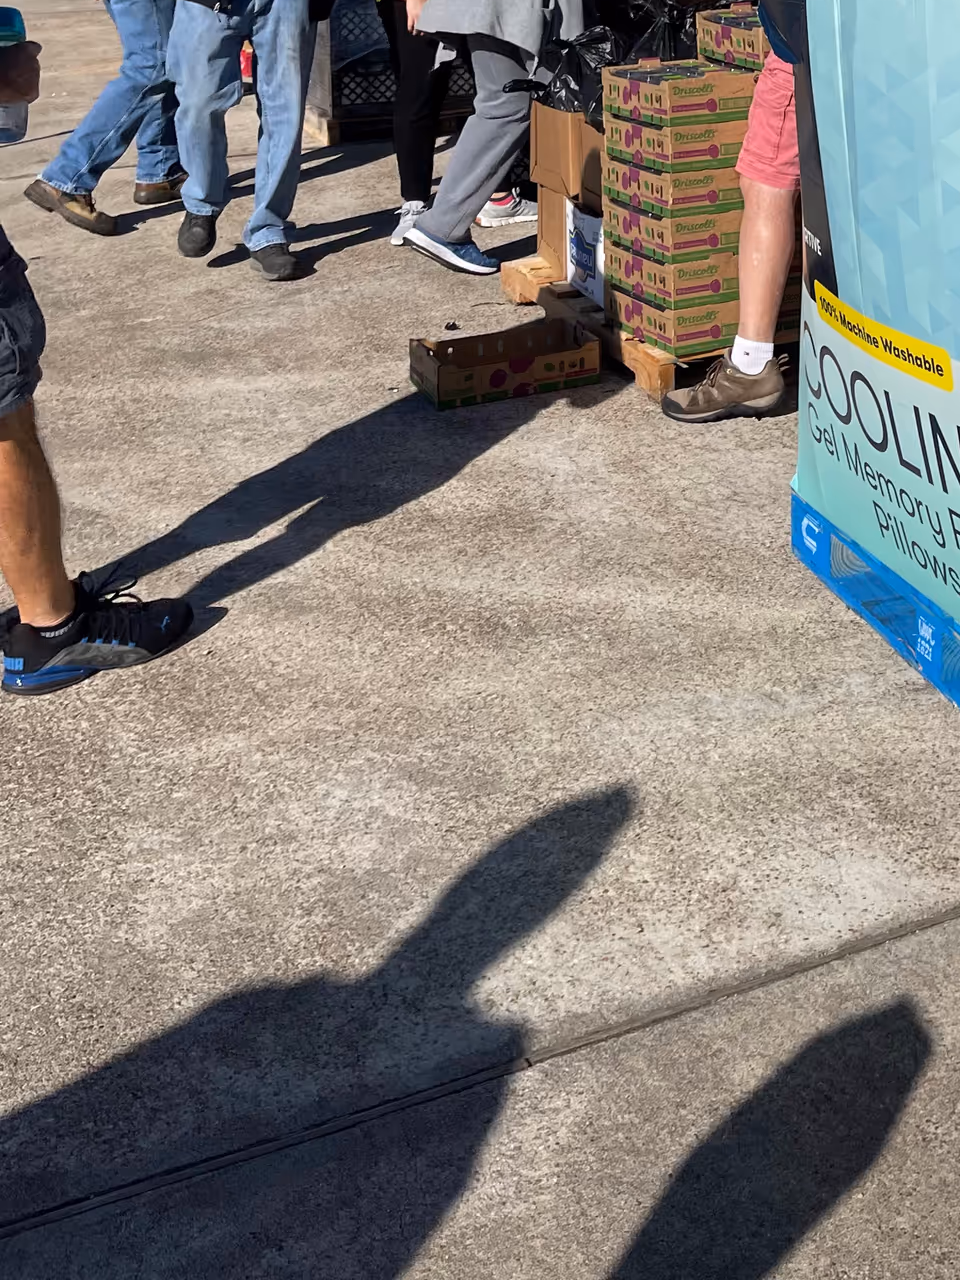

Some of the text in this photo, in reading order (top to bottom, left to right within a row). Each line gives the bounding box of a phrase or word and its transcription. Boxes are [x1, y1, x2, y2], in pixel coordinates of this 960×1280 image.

[819, 295, 945, 377] 100% Machine Washable
[807, 402, 840, 462] Gel
[841, 432, 946, 549] Memory
